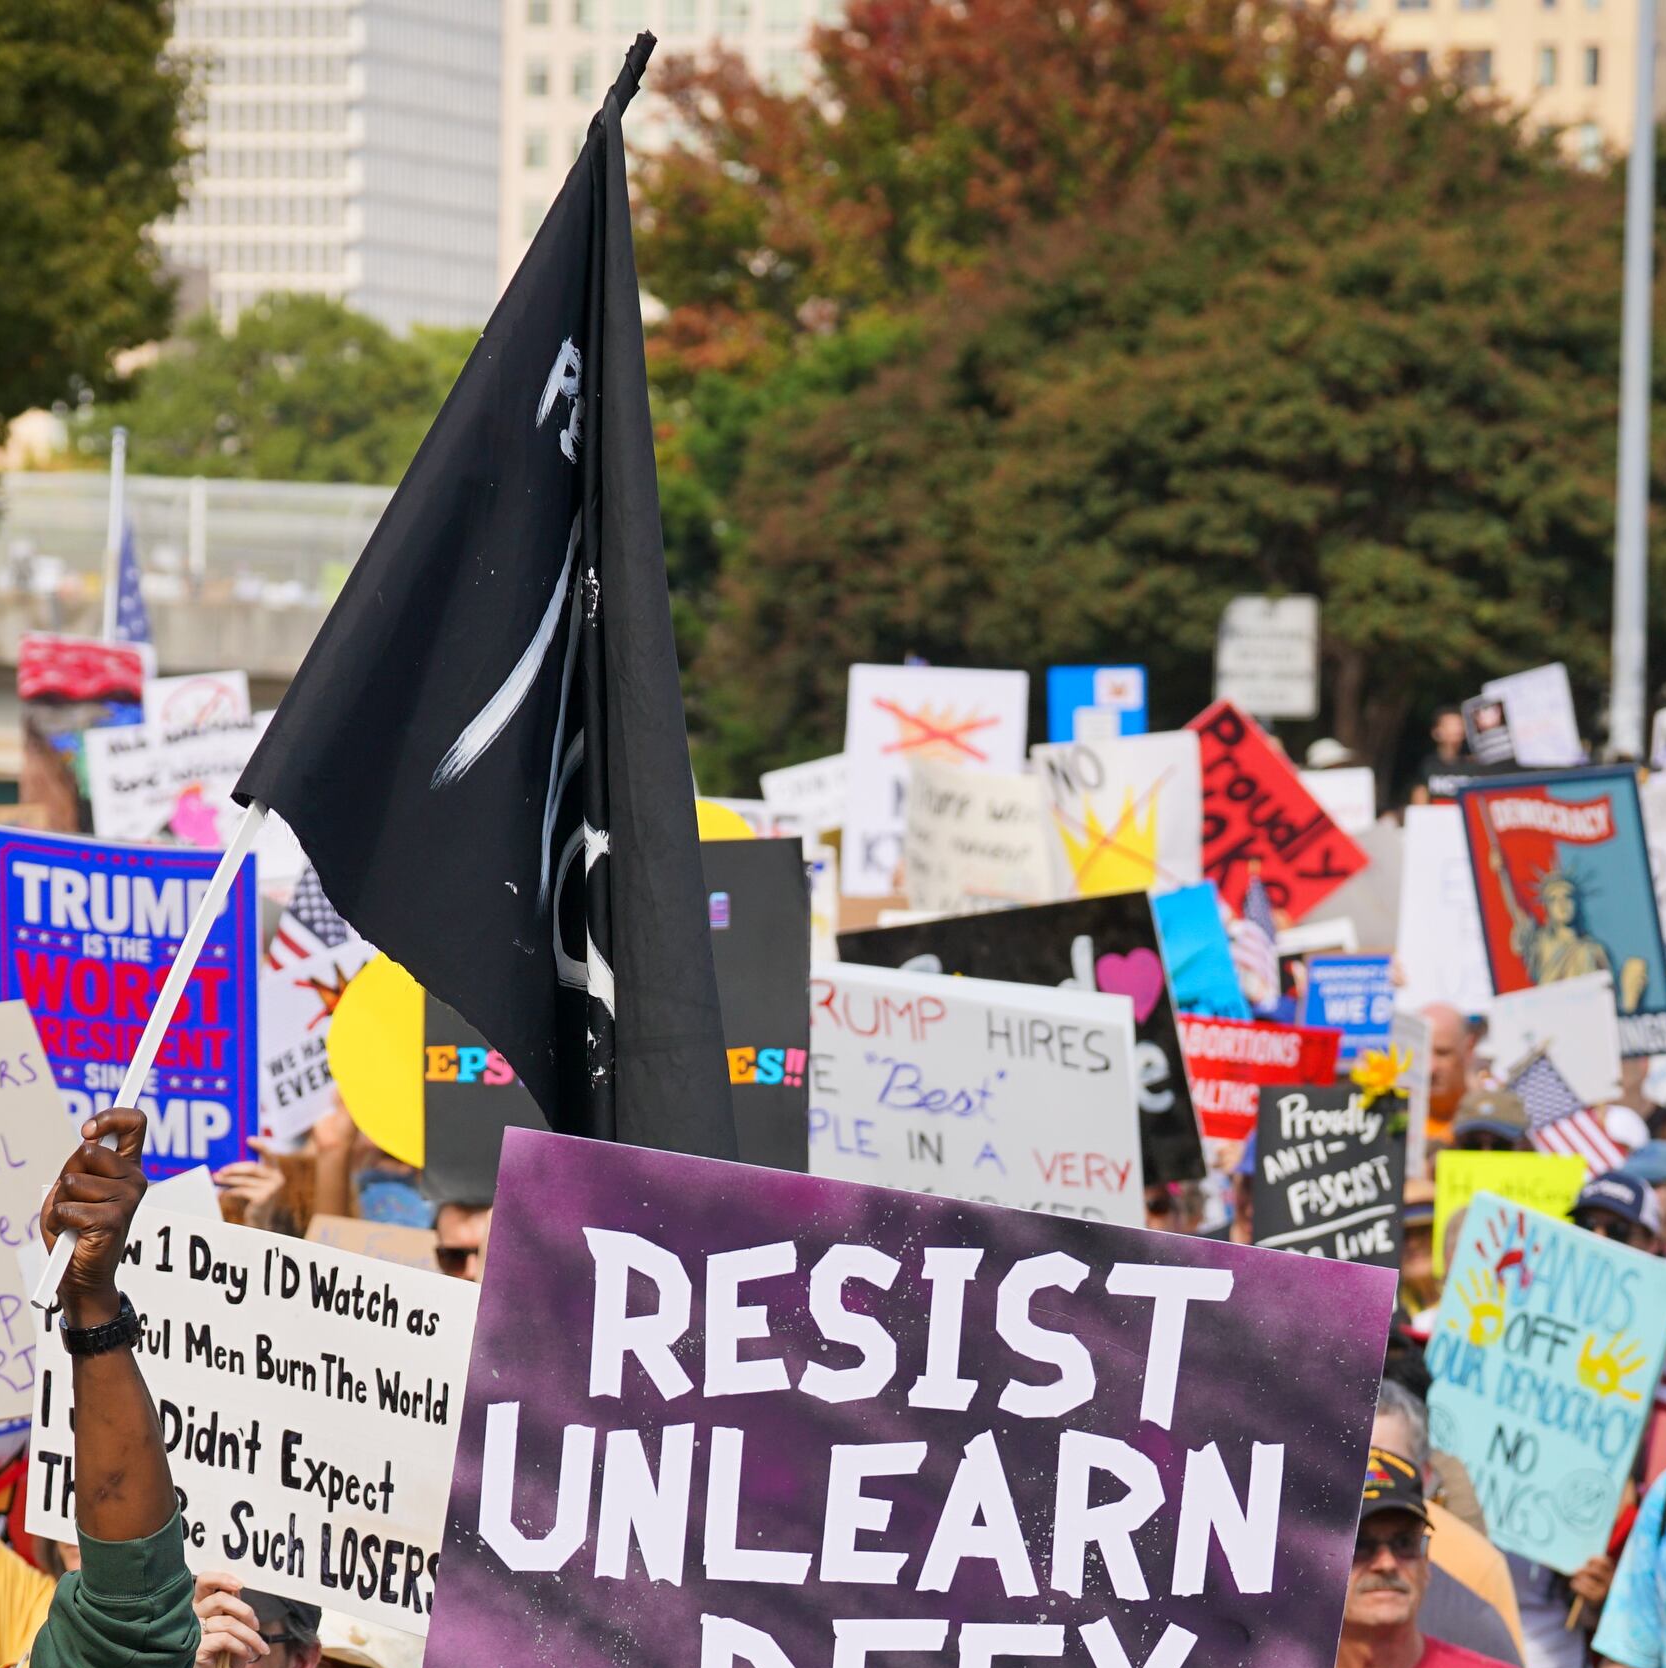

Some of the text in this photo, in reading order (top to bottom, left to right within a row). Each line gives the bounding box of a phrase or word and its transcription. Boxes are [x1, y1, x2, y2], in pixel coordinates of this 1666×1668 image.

[1046, 743, 1106, 798] NO
[1489, 798, 1610, 840] DEMOCRACY
[83, 932, 152, 963] IS THE
[36, 1017, 230, 1070] RESIENT
[810, 978, 1112, 1074] RUMP HIRES
[84, 1062, 159, 1095] SINE
[267, 1047, 297, 1078] WE
[1277, 1091, 1383, 1147] Proudly
[907, 1129, 1133, 1193] IN A VERY
[1263, 1139, 1346, 1185] ANTI-
[1287, 1155, 1393, 1225] FASCIST
[155, 1226, 174, 1273] 1
[189, 1234, 248, 1305] Day
[309, 1260, 399, 1328] Watch
[406, 1307, 441, 1337] as
[581, 1225, 1235, 1434] RESIST
[1504, 1315, 1581, 1366] OFF
[184, 1321, 449, 1425] Men Burn The World
[41, 1369, 395, 1514] I Didn't Expect
[1487, 1425, 1541, 1477] NO
[476, 1400, 1286, 1603] UNLEARN
[222, 1500, 305, 1578] Such
